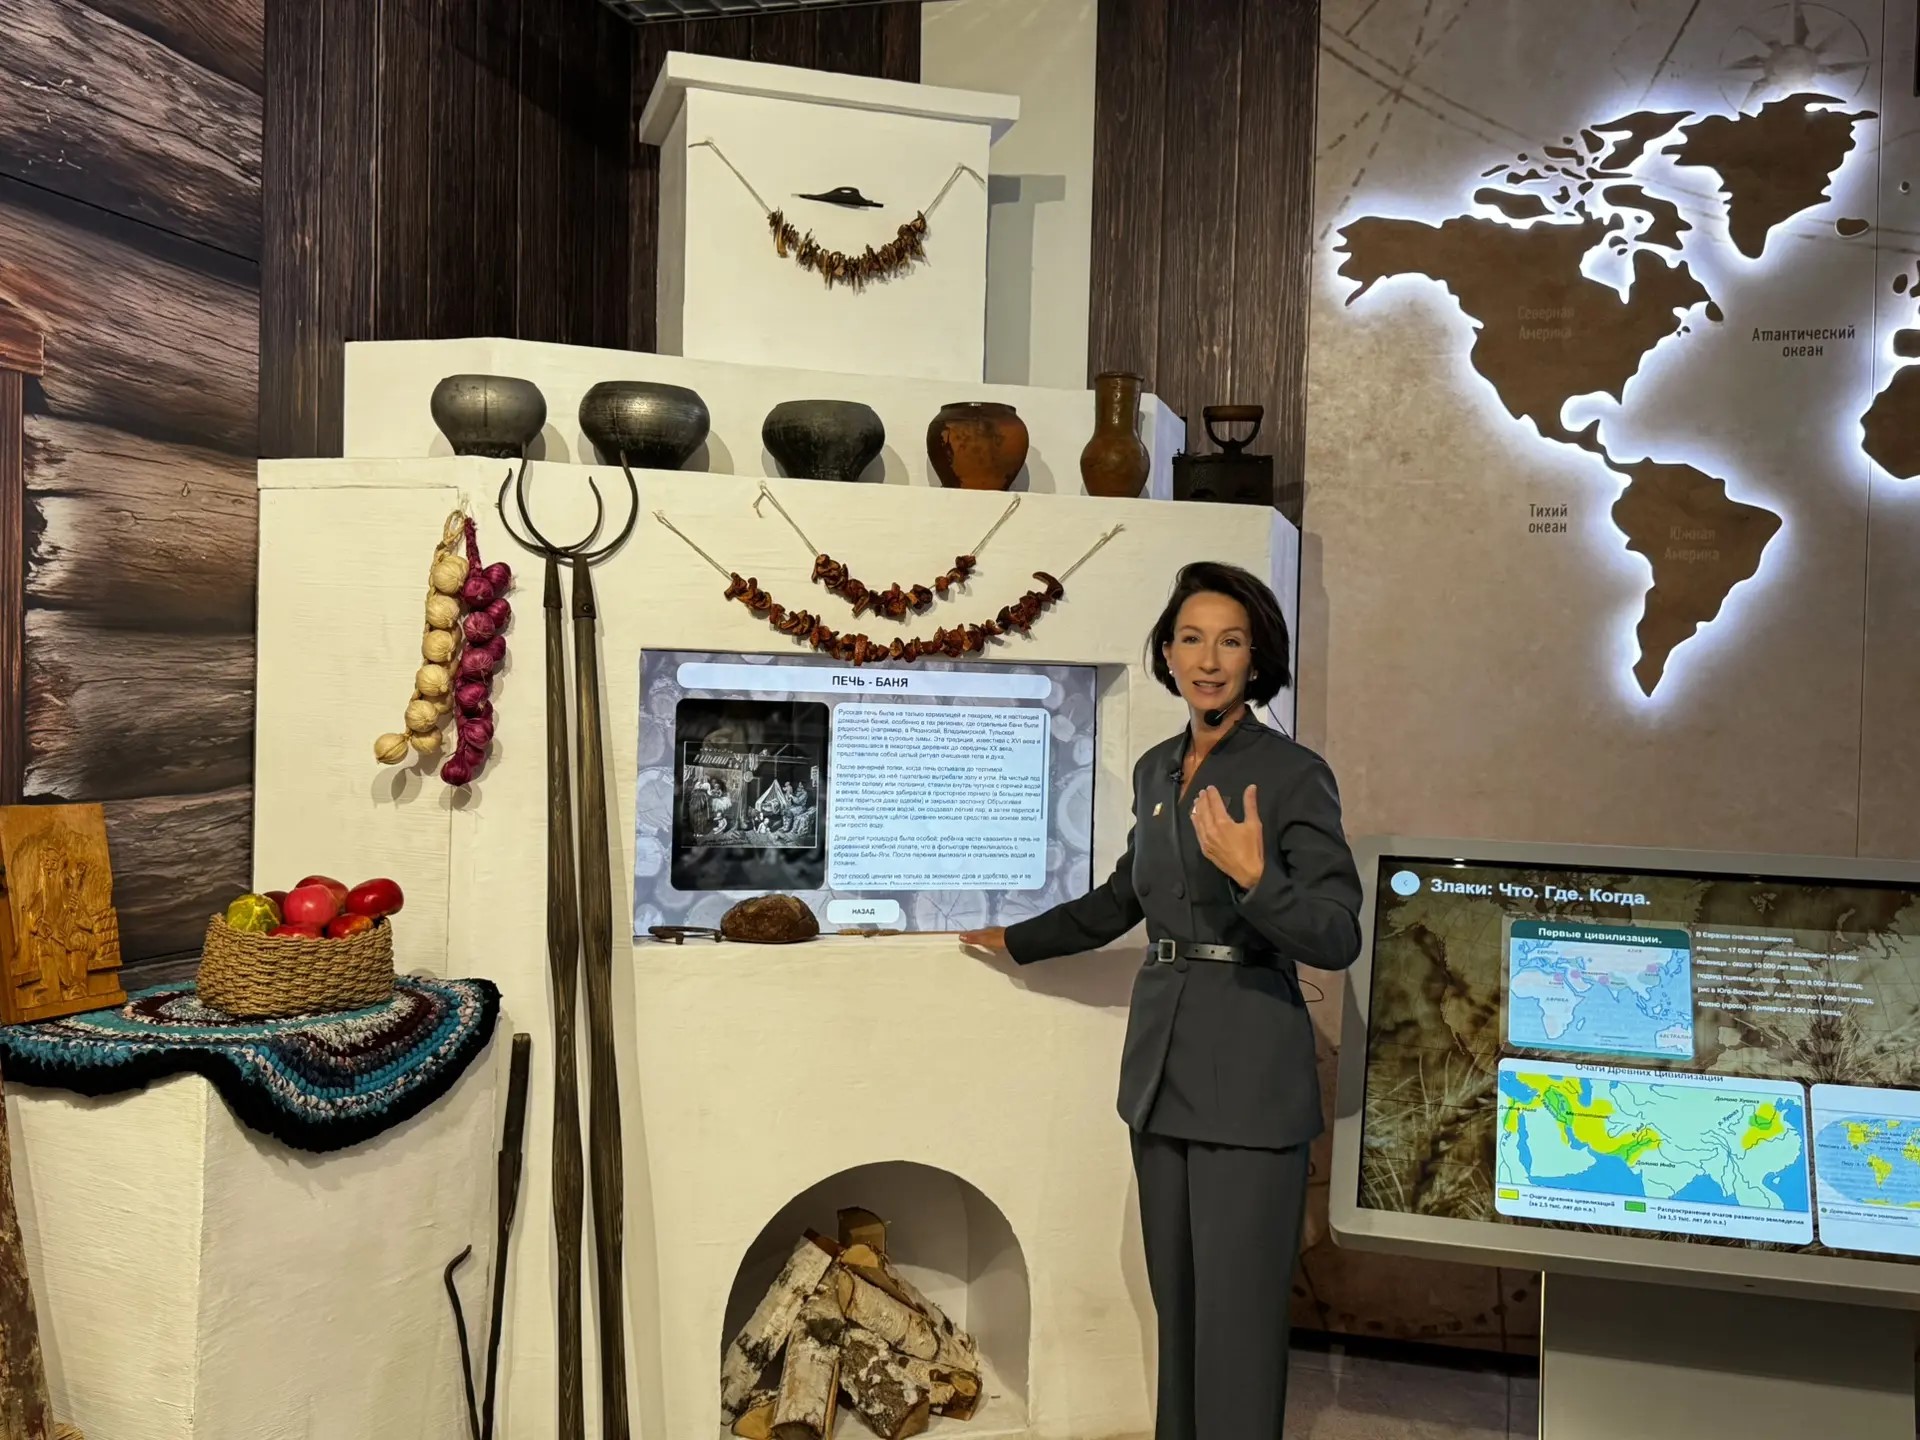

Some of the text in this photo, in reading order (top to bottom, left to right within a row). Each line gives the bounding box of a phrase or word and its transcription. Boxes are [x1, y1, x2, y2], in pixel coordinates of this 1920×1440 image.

[1752, 325, 1855, 342] Атлантический
[1782, 346, 1823, 357] океан
[1530, 504, 1567, 517] Тихий
[1529, 523, 1567, 533] океан
[832, 676, 865, 686] ПЕЧЬ
[876, 677, 908, 687] БАНЯ
[1431, 878, 1651, 907] Злаки: Что. Где. Когда.
[1537, 927, 1663, 945] Первые цивилизации.
[1575, 1064, 1605, 1073] Очаги
[1608, 1066, 1651, 1077] Древних
[1574, 1198, 1615, 1208] цивилизаций
[1657, 1206, 1711, 1217] Распространение
[1766, 1218, 1804, 1226] земледелия
